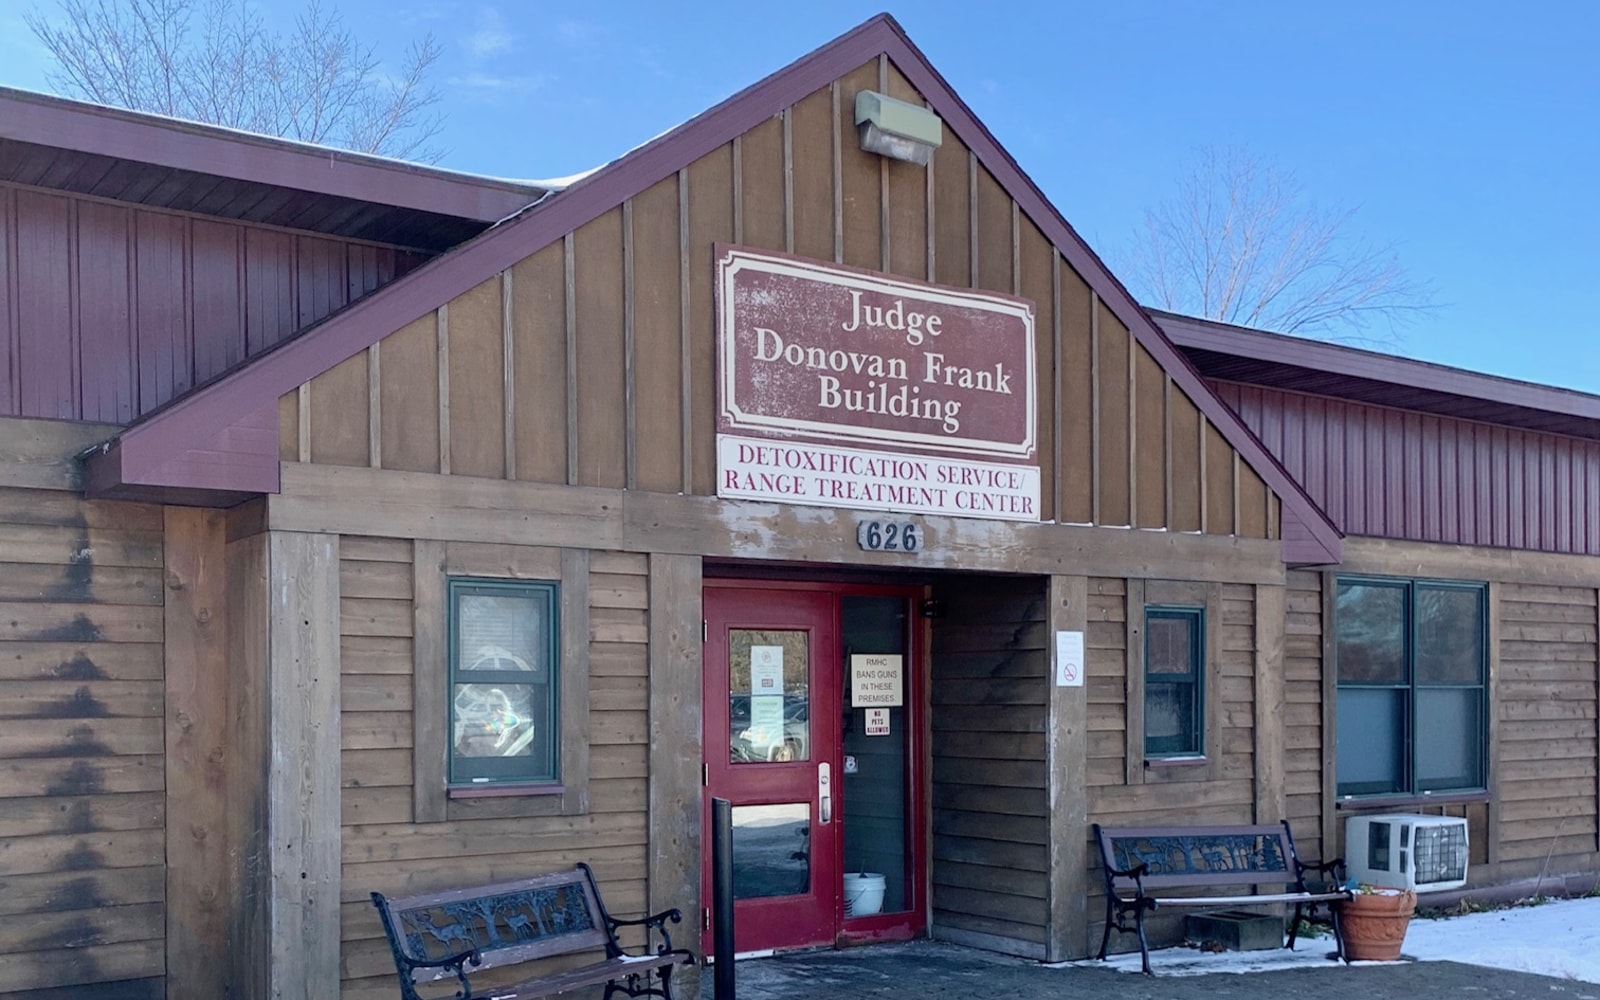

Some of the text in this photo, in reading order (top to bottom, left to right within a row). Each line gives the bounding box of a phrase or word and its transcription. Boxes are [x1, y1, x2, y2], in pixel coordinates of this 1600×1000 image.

[842, 290, 942, 346] Judge
[753, 327, 1012, 395] Donovan Frank
[818, 375, 961, 433] Building
[738, 444, 1026, 491] DETOXIFICATION SERVICE/
[724, 470, 1034, 515] RANGE TREATMENT CENTER
[866, 521, 918, 551] 626
[856, 670, 898, 679] BANS GUNS
[866, 658, 888, 666] RMHC
[861, 682, 893, 691] IN THESE
[867, 726, 889, 734] ALLOWED
[871, 718, 884, 726] PETS
